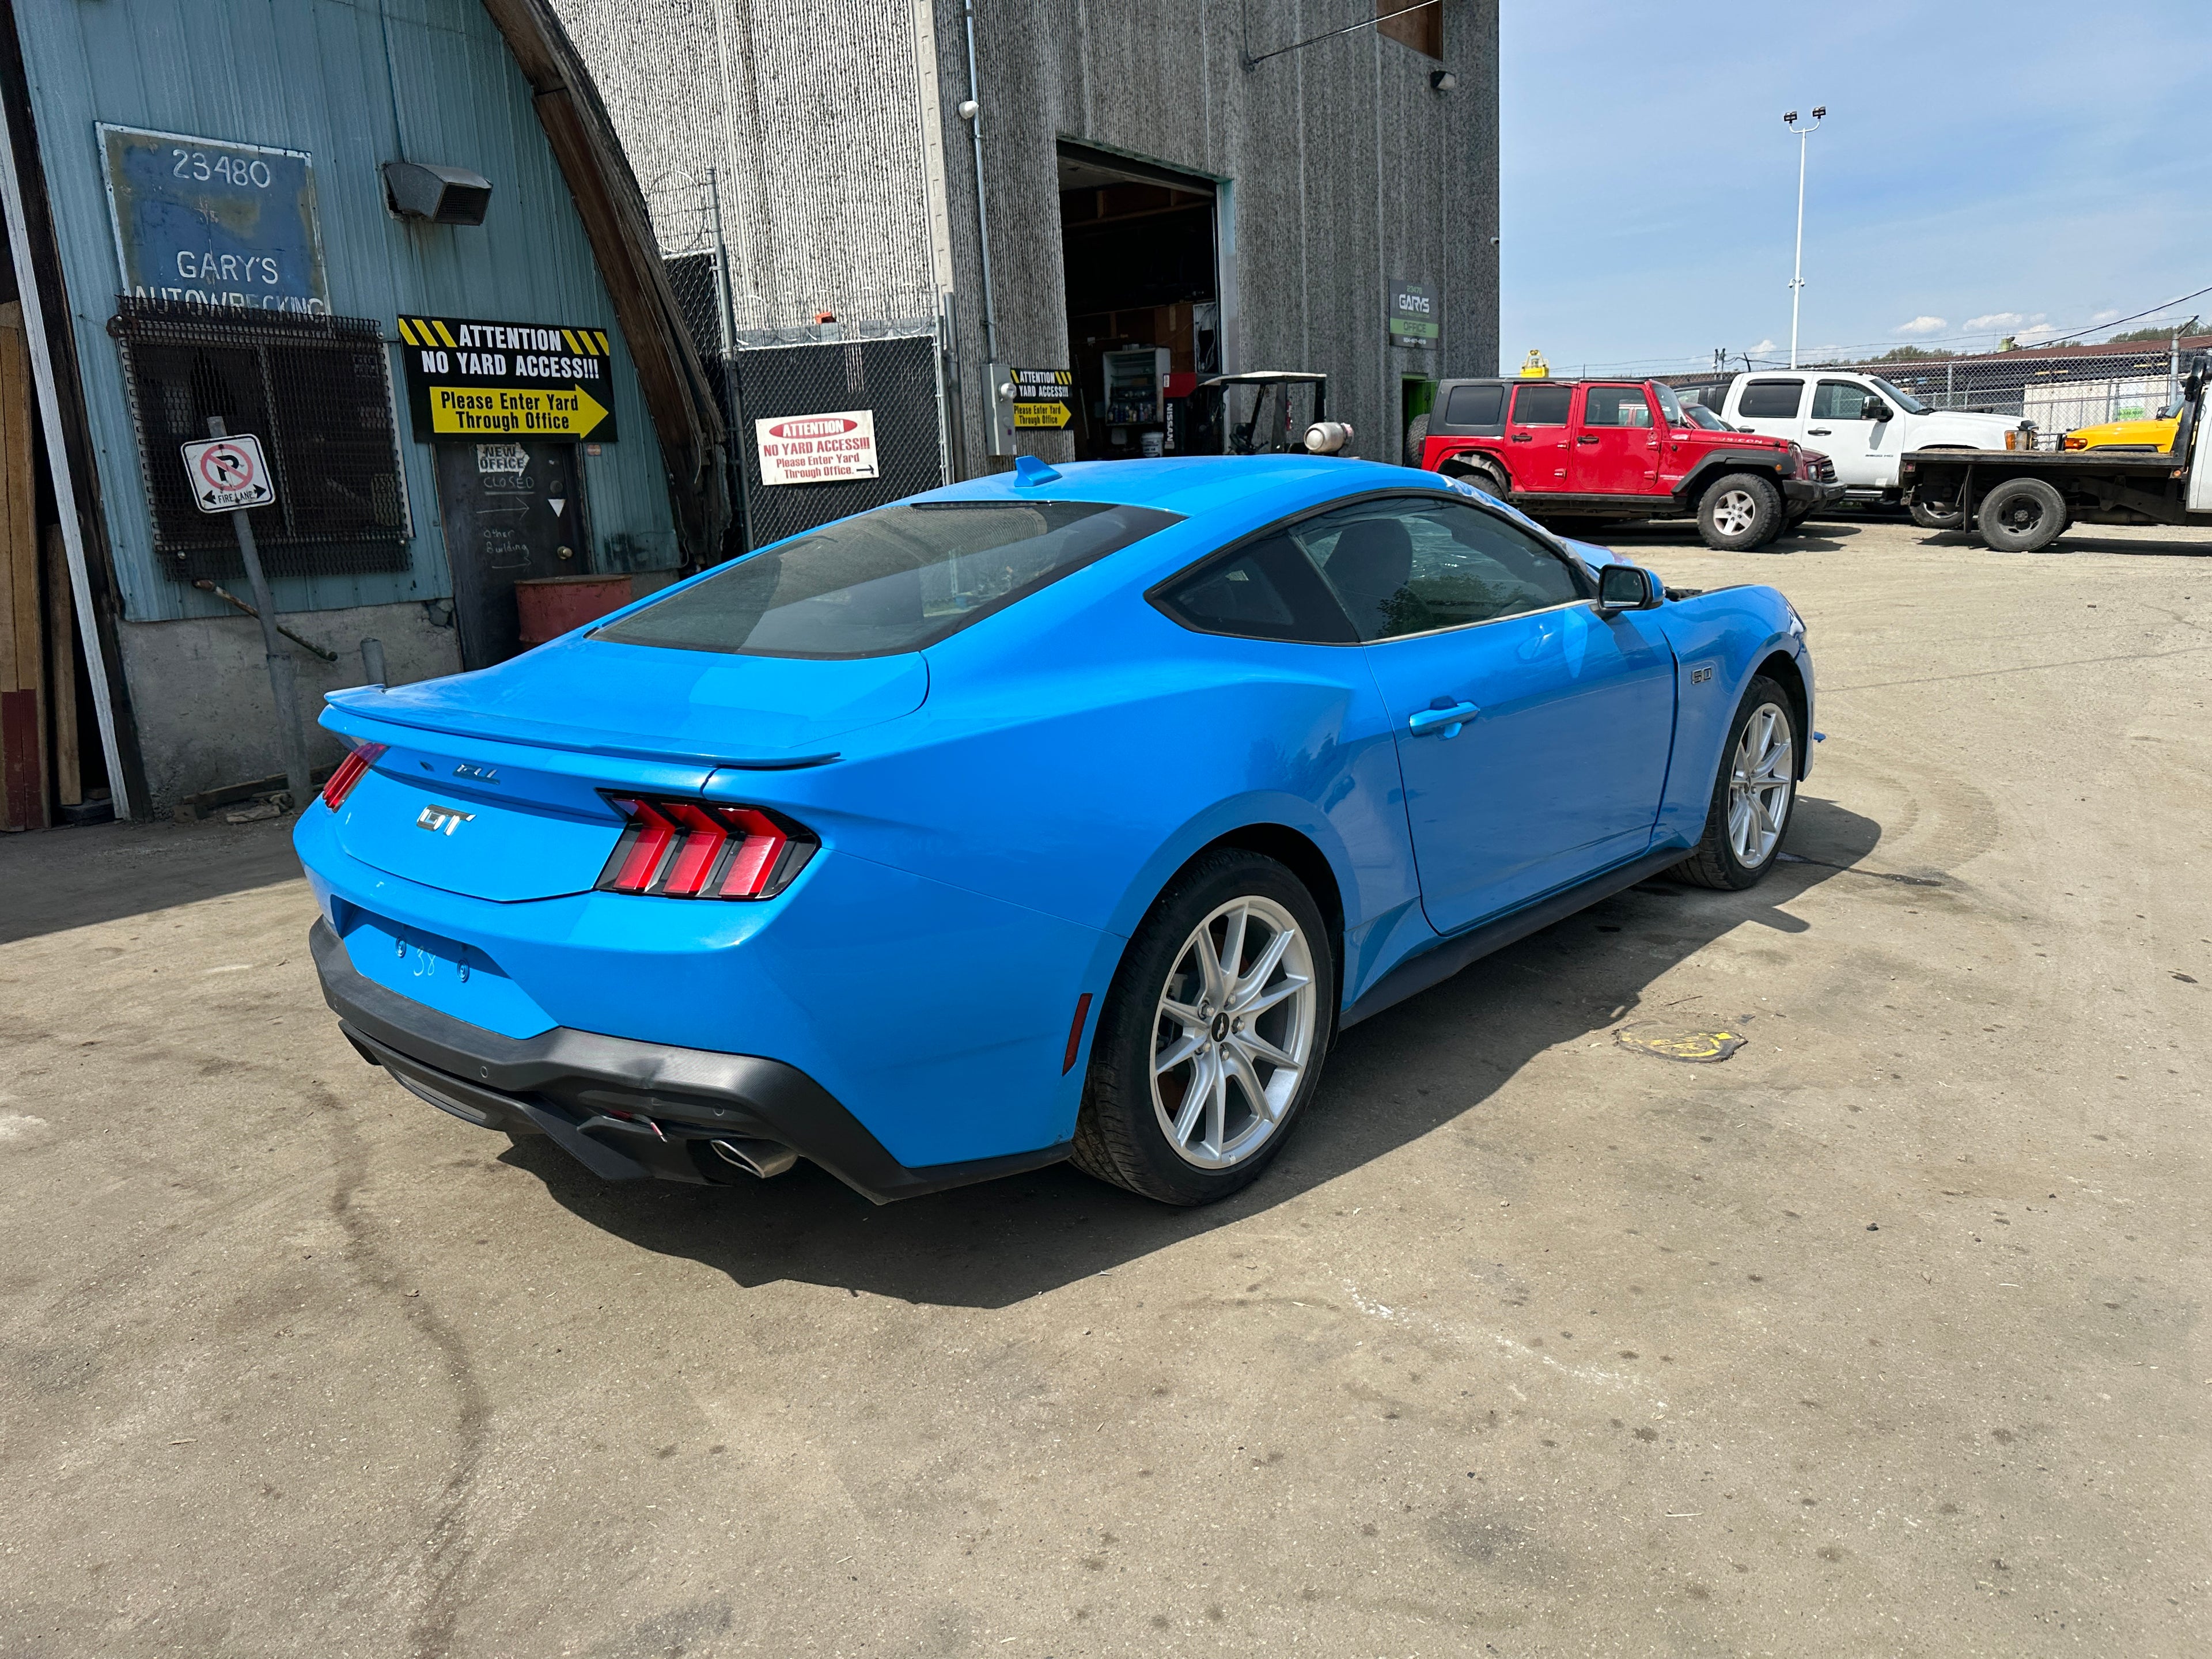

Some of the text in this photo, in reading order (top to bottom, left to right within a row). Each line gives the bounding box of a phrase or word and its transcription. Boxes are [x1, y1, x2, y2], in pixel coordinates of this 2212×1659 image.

[173, 149, 270, 188] 23480
[177, 251, 278, 284] GARY'S
[1399, 294, 1430, 313] GARYS
[1404, 321, 1426, 333] OFFICE
[460, 324, 562, 351] ATTENTION
[421, 351, 599, 379] NO YARD ACCESS!!!
[1020, 371, 1055, 384] ATTENTION
[1019, 385, 1069, 397] YARD ACCESS!!!
[441, 391, 578, 411] Please Enter Yard
[1014, 405, 1061, 414] Please Enter Yard
[456, 411, 569, 431] Through Office
[1019, 415, 1058, 425] Through Office
[783, 419, 844, 437] ATTENTION
[486, 446, 516, 457] NEW
[763, 437, 870, 457] NO YARD ACCESS!!!
[480, 457, 525, 469] OFFICE
[777, 453, 859, 468] Please Enter Yard
[784, 468, 821, 479] Through
[484, 476, 535, 488] CLOSED
[218, 491, 255, 503] FIRE LANE
[484, 529, 514, 538] Other
[416, 804, 477, 836] GT
[413, 945, 436, 976] 38
